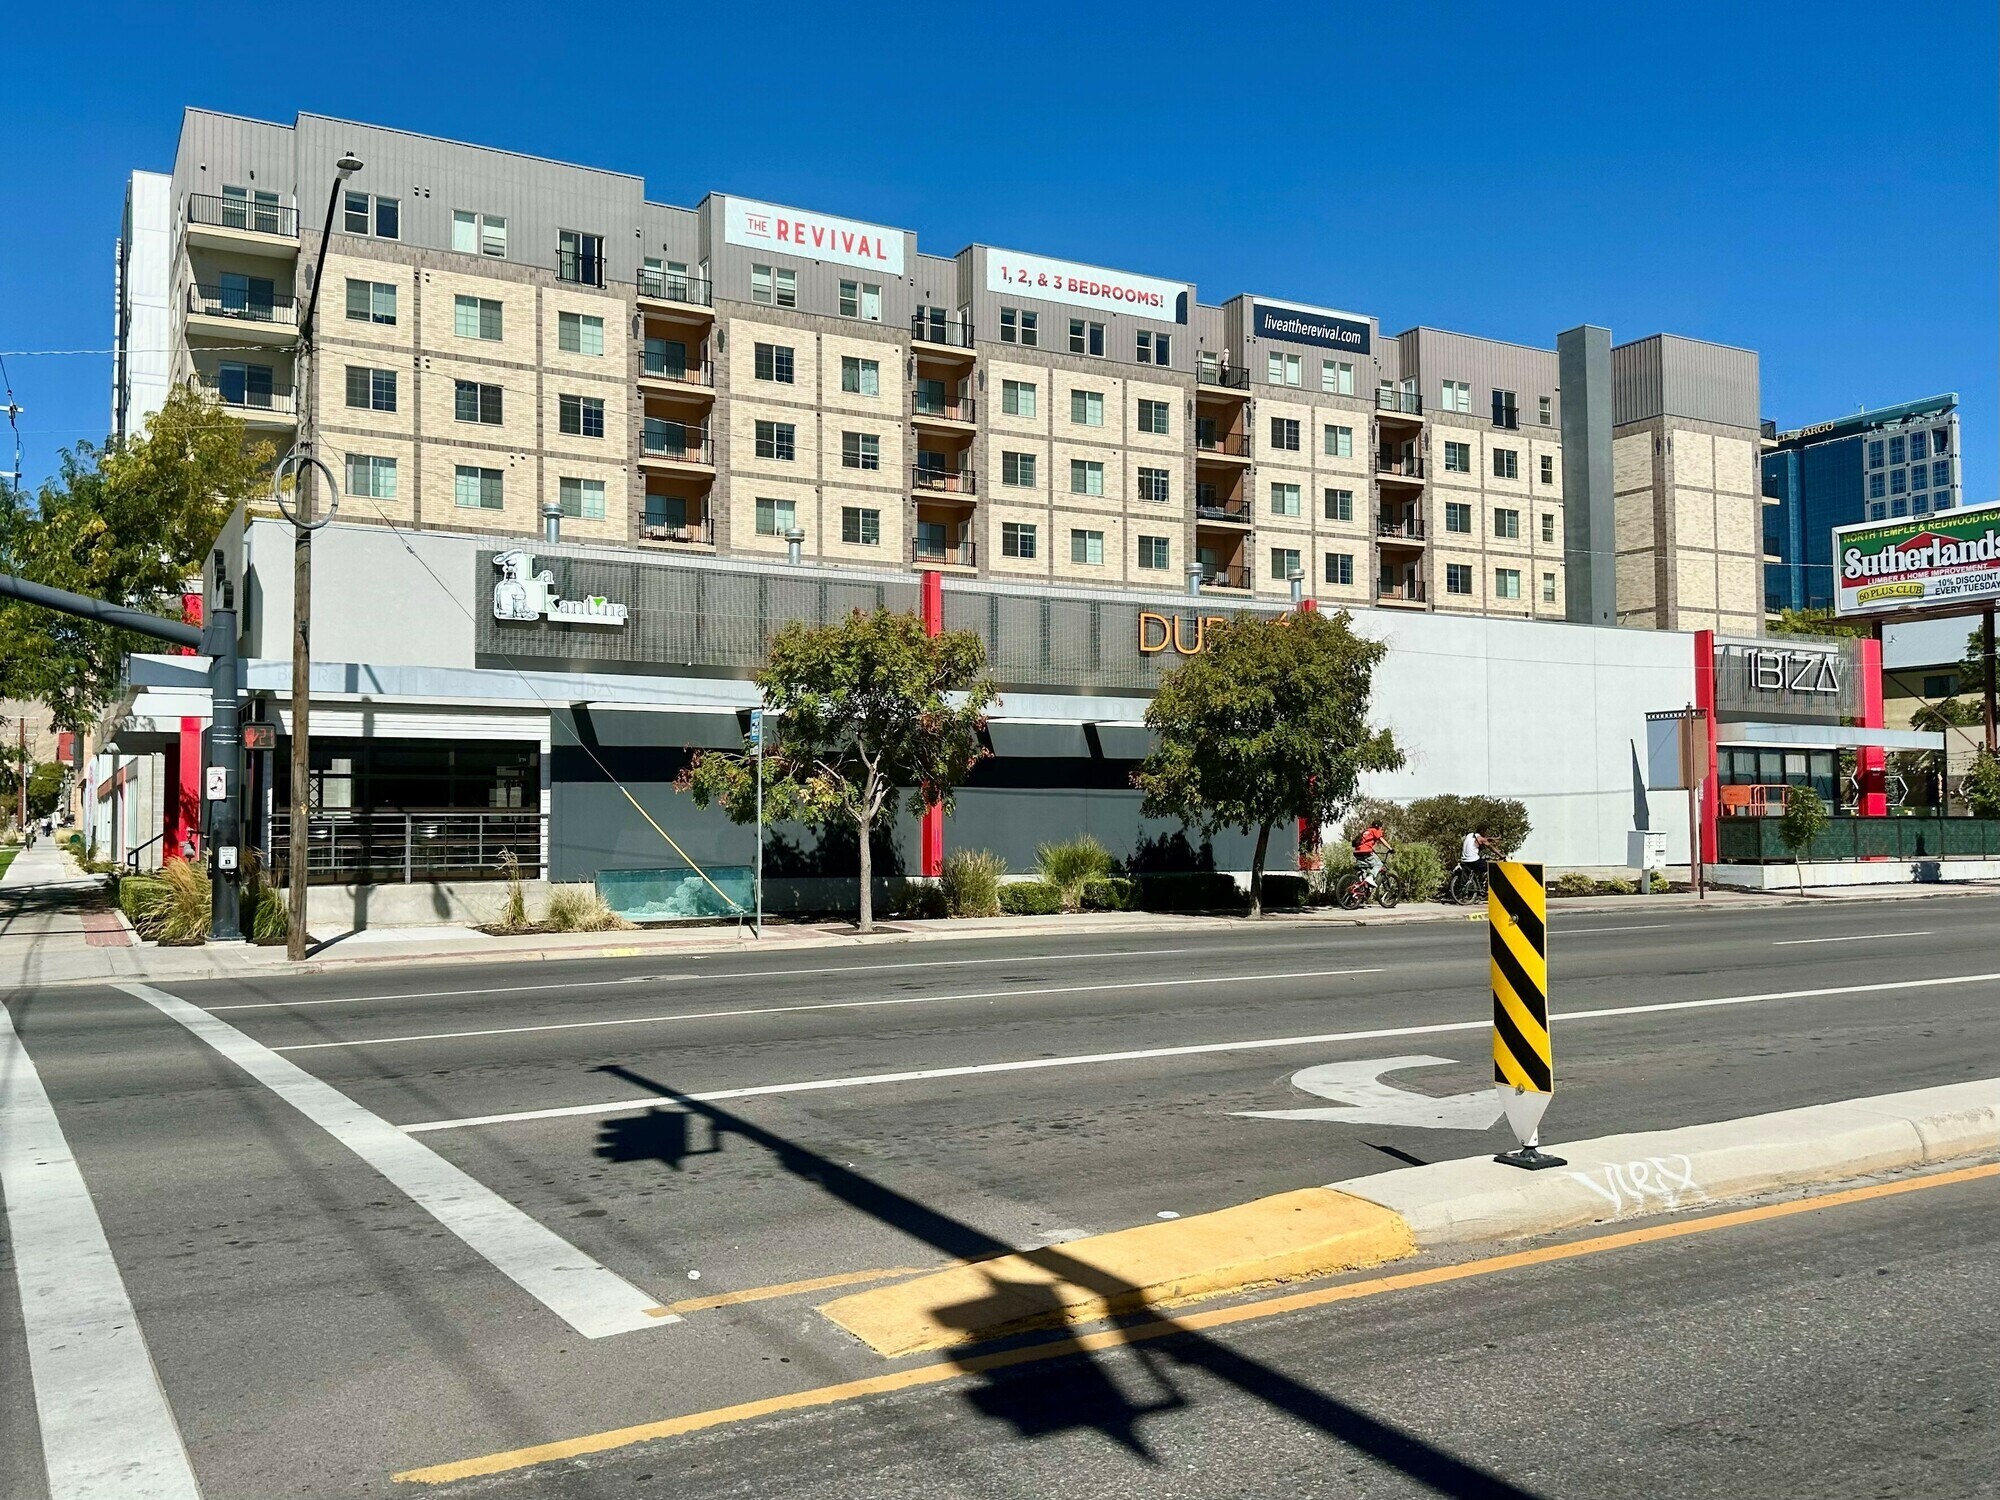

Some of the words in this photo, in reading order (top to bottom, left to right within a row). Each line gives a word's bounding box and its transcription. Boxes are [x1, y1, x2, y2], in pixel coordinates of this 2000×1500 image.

[748, 218, 767, 232] THE
[777, 219, 887, 260] REVIVAL
[1001, 266, 1013, 284] 1,
[1018, 269, 1032, 287] 2,
[1038, 273, 1048, 287] &
[1054, 276, 1062, 289] 3
[1068, 278, 1164, 308] BEDROOMS!
[1264, 313, 1361, 345] liveattherevival.com
[1798, 422, 1834, 438] FARGO
[1843, 530, 1876, 544] NORTH
[1878, 523, 1916, 538] TEMPLE
[1918, 522, 1926, 532] &
[1928, 513, 1980, 531] REDWOOD
[524, 554, 554, 583] La
[1867, 575, 1899, 585] LUMBER
[1907, 571, 1930, 579] HOME
[1931, 563, 1989, 577] IMPROVEMENT
[1938, 577, 1954, 587] 10%
[1956, 572, 1998, 585] DISCOUNT
[1859, 591, 1869, 601] 60
[1871, 586, 1894, 598] PLUS
[1896, 585, 1922, 594] CLUB
[1935, 585, 1962, 596] EVERY
[1750, 652, 1840, 692] IBIZA
